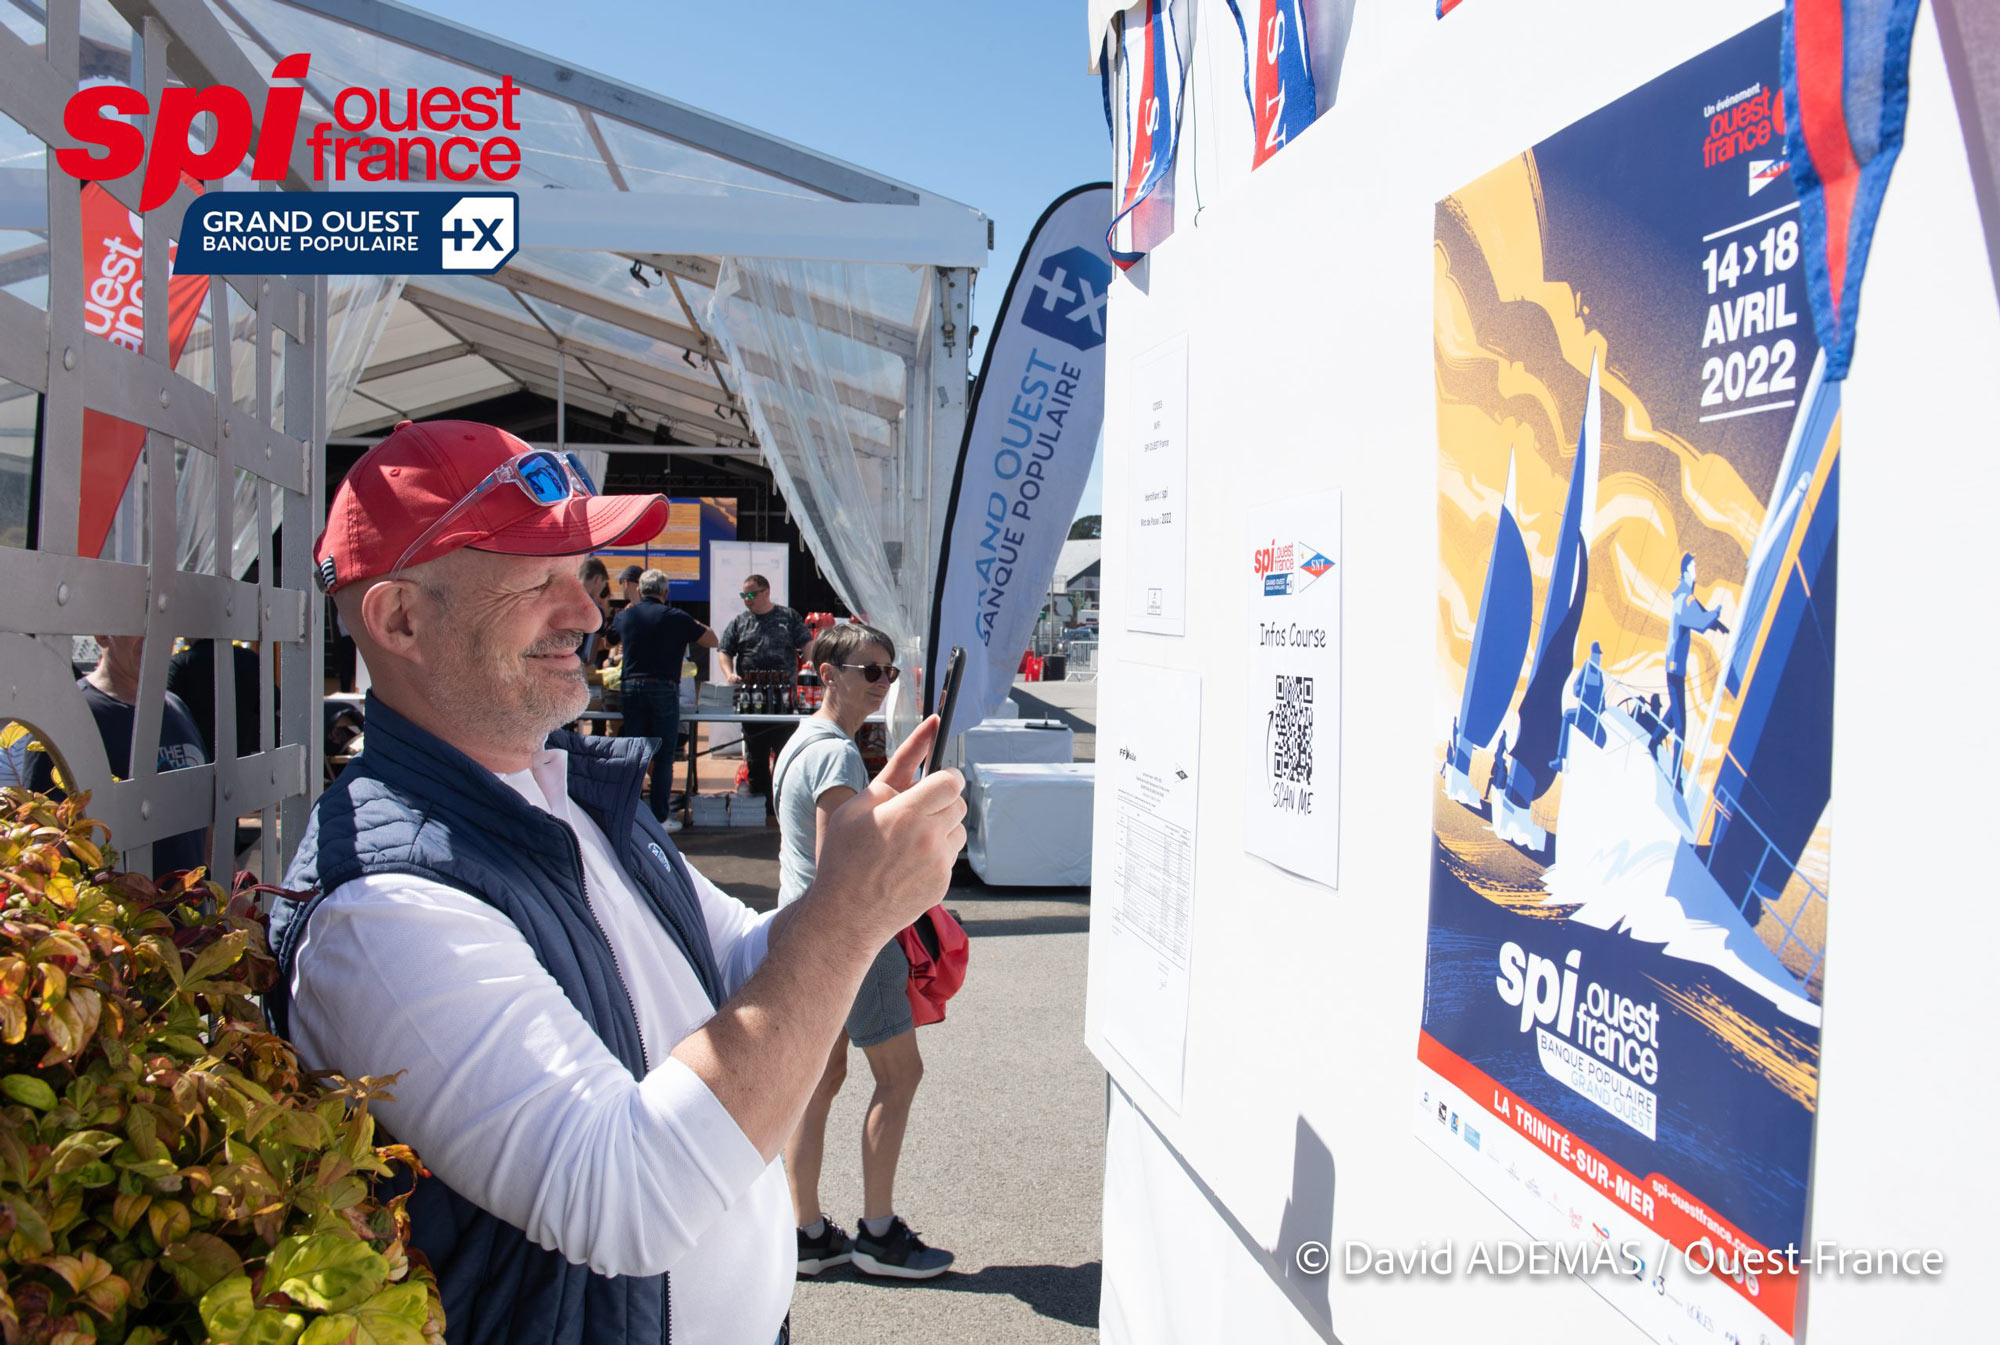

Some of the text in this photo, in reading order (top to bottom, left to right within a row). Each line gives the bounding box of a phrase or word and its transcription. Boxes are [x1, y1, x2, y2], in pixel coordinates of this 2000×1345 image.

[1703, 82, 1760, 118] Un événement
[1710, 86, 1772, 136] ouest
[1703, 119, 1771, 168] france
[85, 236, 143, 335] uest
[1701, 283, 1797, 349] AVRIL
[1700, 338, 1796, 407] 2022
[994, 348, 1058, 481] OUEST
[1012, 360, 1082, 522] POPULAIRE
[1254, 539, 1275, 581] spi
[1275, 555, 1294, 572] france
[1276, 542, 1294, 558] ouest
[1259, 622, 1327, 648] Infos Course
[1272, 781, 1314, 815] SCAN ME
[1496, 941, 1582, 1038] spi
[1586, 982, 1660, 1049] ouest
[1541, 1034, 1653, 1114] BANQUE POPULAIRE
[1576, 999, 1658, 1085] france
[1570, 1071, 1652, 1131] GRAND OUEST
[1494, 1090, 1510, 1118] LA
[1515, 1104, 1655, 1221] TRINITÉ-SUR-MER
